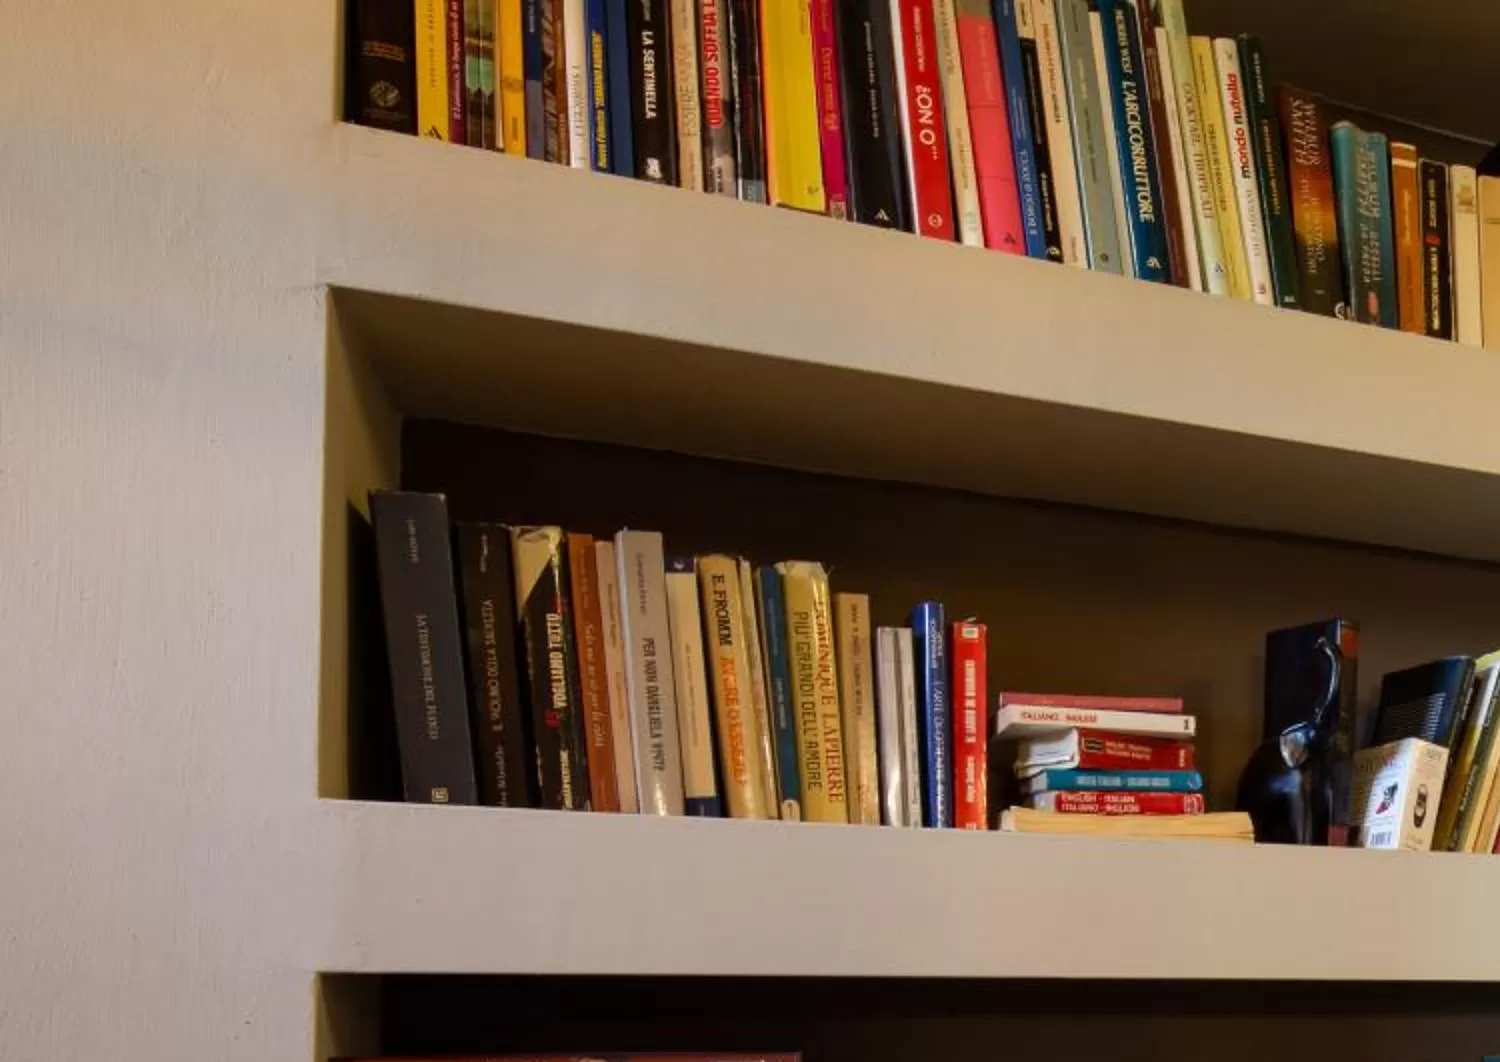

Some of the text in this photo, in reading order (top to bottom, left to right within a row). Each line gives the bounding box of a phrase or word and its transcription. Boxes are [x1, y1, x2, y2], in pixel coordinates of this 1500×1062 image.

[642, 30, 655, 45] LA
[642, 49, 657, 119] SENTINELLA
[703, 14, 722, 129] QUANDO SOFFIA
[1182, 83, 1201, 148] COCKTAIL
[1227, 72, 1253, 180] mondo nutella
[1123, 79, 1156, 224] L'ARCICORRUTTORE
[642, 637, 655, 657] PER
[713, 590, 732, 647] FROMM
[485, 648, 499, 677] DELLA
[545, 612, 567, 709] VOGLIAMO TUTTO
[644, 659, 657, 683] NON
[797, 641, 814, 697] GRANDI
[801, 700, 818, 738] DELL'
[806, 740, 823, 790] AMORE
[823, 712, 844, 803] LAPIERRE
